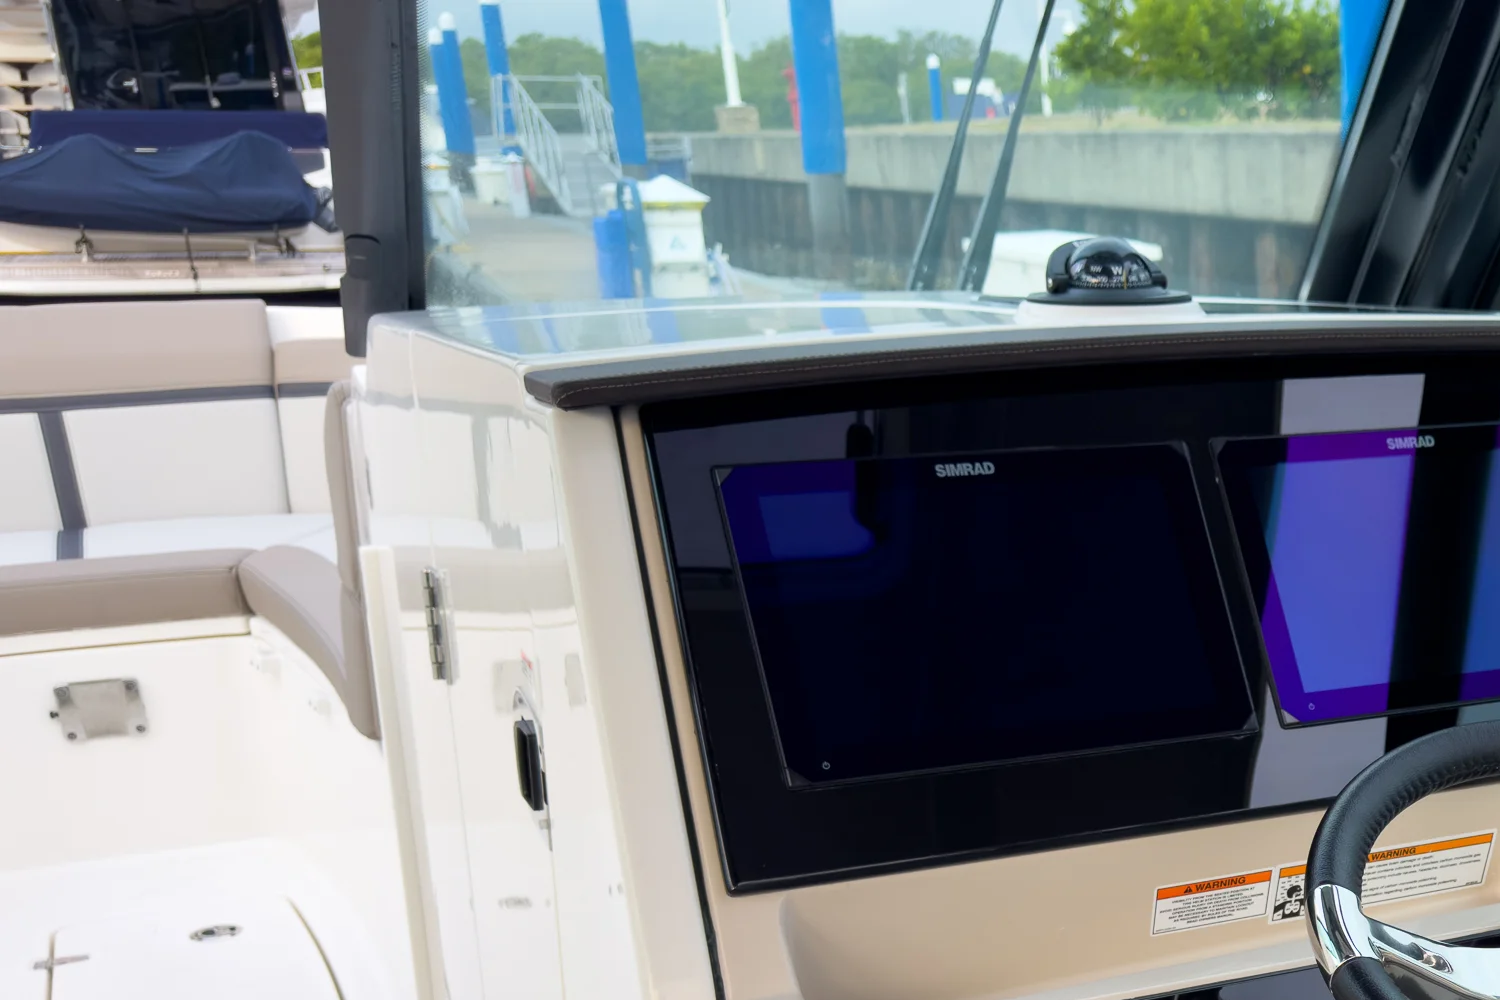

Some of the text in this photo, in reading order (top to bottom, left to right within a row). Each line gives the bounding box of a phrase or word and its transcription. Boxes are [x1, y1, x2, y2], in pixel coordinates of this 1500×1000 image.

[1386, 435, 1435, 450] SIMRAD
[935, 461, 995, 478] SIMRAD
[1371, 848, 1417, 861] WARNING
[1196, 877, 1246, 891] WARNING
